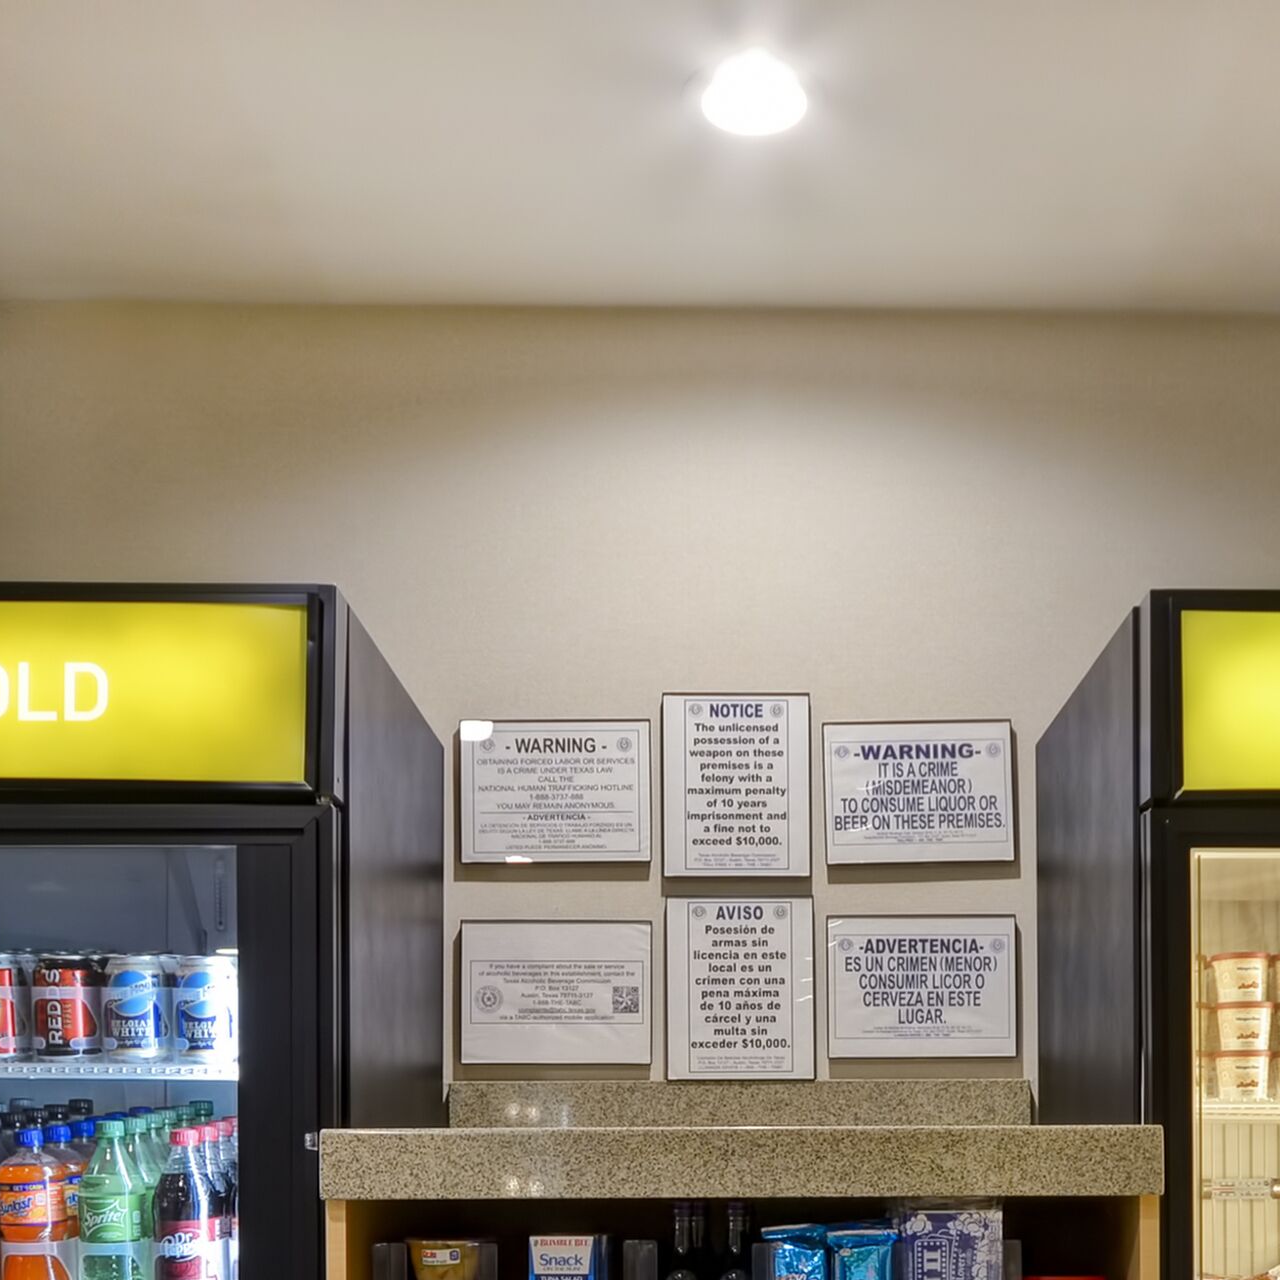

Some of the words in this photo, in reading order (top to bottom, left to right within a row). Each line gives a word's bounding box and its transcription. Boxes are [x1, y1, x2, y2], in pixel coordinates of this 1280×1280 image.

[709, 704, 763, 718] NOTICE
[694, 723, 715, 732] The
[719, 723, 779, 732] unlicensed
[515, 738, 596, 753] WARNING
[693, 736, 755, 746] possession
[759, 736, 769, 744] of
[689, 750, 732, 759] weapon
[753, 748, 784, 757] these
[854, 743, 981, 760] -WARNING-
[700, 761, 750, 772] premises
[754, 761, 763, 770] is
[878, 762, 889, 778] IT
[892, 762, 904, 778] IS
[907, 762, 916, 778] A
[919, 761, 958, 778] CRIME
[701, 774, 734, 785] felony
[738, 774, 762, 782] with
[687, 786, 742, 795] maximum
[745, 786, 786, 797] penalty
[707, 799, 717, 807] of
[722, 799, 734, 807] 10
[737, 801, 767, 809] years
[841, 798, 858, 813] TO
[861, 797, 924, 813] CONSUME
[928, 796, 976, 812] LIQUOR
[979, 795, 998, 811] OR
[687, 811, 763, 822] imprisonment
[766, 811, 787, 820] and
[835, 815, 868, 831] BEER
[872, 814, 891, 830] ON
[894, 814, 935, 830] THESE
[939, 812, 1006, 829] PREMISES.
[714, 824, 734, 832] fine
[738, 824, 756, 832] not
[760, 824, 771, 832] to
[692, 837, 732, 845] exceed
[736, 836, 782, 847] $10,000.
[716, 906, 763, 920] AVISO
[705, 925, 757, 935] Posesión
[761, 925, 775, 935] de
[751, 938, 768, 947] sin
[859, 938, 984, 954] -ADVERTENCIA-
[693, 951, 739, 960] licencia
[761, 951, 787, 960] este
[708, 963, 737, 972] local
[845, 956, 861, 972] ES
[865, 956, 883, 972] UN
[887, 956, 937, 972] CRIMEN
[940, 956, 998, 972] (MENOR)
[695, 976, 735, 985] crimen
[859, 974, 928, 989] CONSUMIR
[932, 974, 971, 989] LICOR
[975, 974, 985, 989] O
[701, 990, 729, 999] pena
[734, 988, 779, 997] máxima
[862, 991, 924, 1007] CERVEZA
[927, 991, 944, 1007] EN
[948, 991, 981, 1007] ESTE
[700, 1001, 714, 1010] de
[719, 1001, 731, 1010] 10
[735, 1001, 763, 1010] años
[767, 1001, 781, 1010] de
[705, 1014, 741, 1023] cárcel
[745, 1016, 752, 1025] y
[898, 1008, 947, 1024] LUGAR.
[714, 1027, 747, 1035] multa
[751, 1027, 768, 1035] sin
[691, 1039, 738, 1049] exceder
[741, 1039, 791, 1050] $10,000.
[84, 1206, 120, 1229] Sprite
[540, 1253, 583, 1267] Snack
